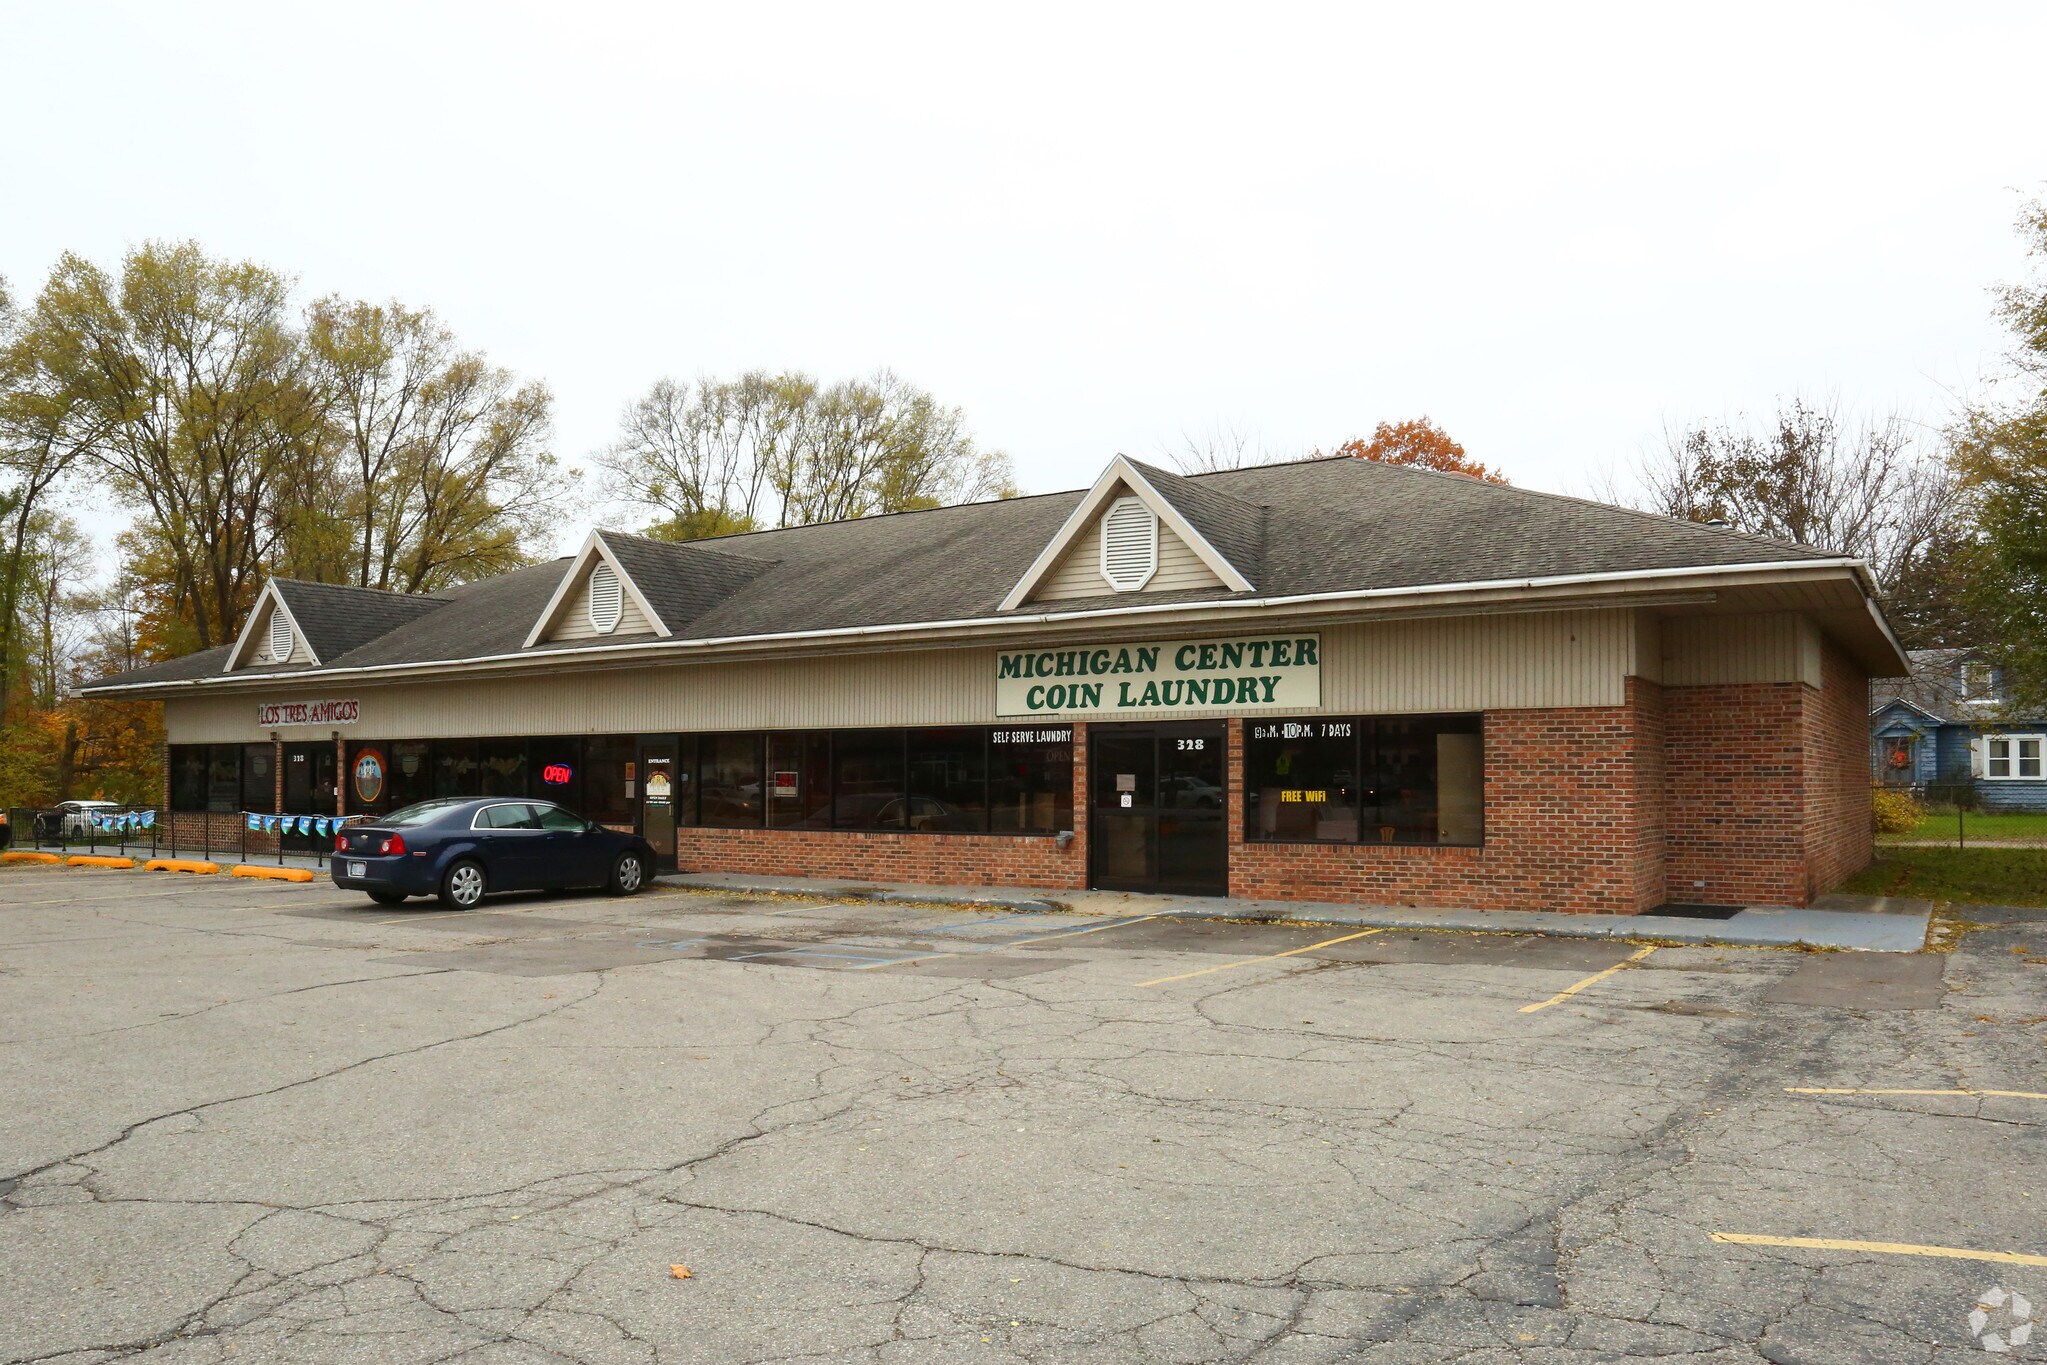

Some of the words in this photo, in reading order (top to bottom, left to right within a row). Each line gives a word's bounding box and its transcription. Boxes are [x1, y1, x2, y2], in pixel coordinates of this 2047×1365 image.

[998, 646, 1161, 680] MICHIGAN
[1174, 638, 1318, 672] CENTER
[1026, 682, 1104, 710] COIN
[1117, 675, 1282, 707] LAUNDRY
[260, 705, 280, 724] LOS
[281, 703, 308, 723] TRES
[311, 700, 358, 722] AMIGOS
[992, 731, 1010, 744] SELF
[1011, 730, 1034, 743] SERVE
[1036, 730, 1072, 743] LAUNDRY
[1321, 723, 1326, 737] 7
[1328, 723, 1351, 737] DAYS
[1177, 738, 1205, 750] 328
[543, 765, 570, 783] OPEN
[1281, 790, 1302, 802] FREE
[1305, 790, 1326, 802] WiFi
